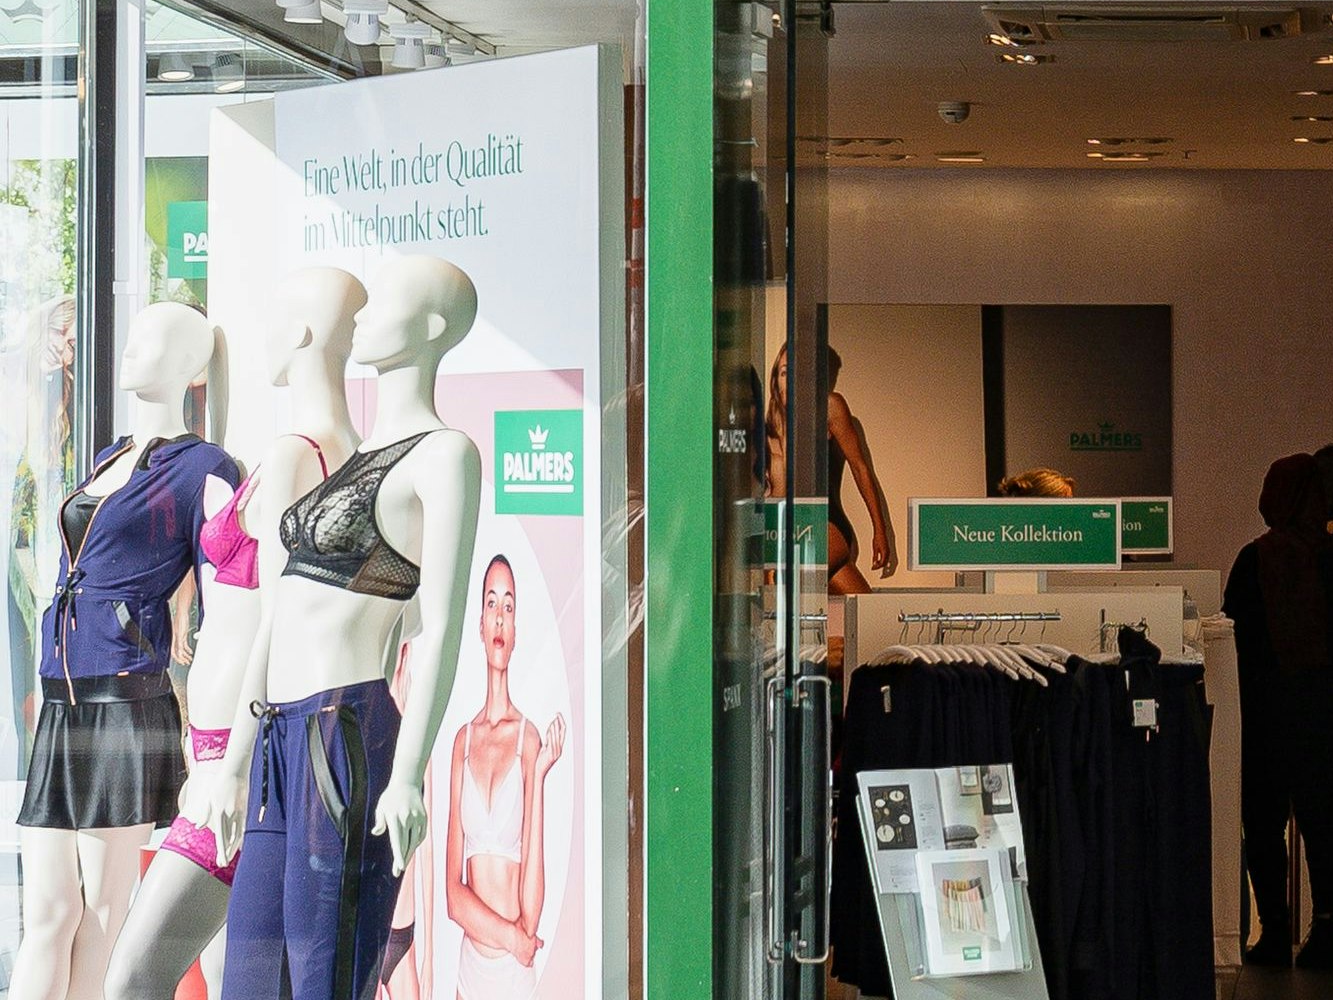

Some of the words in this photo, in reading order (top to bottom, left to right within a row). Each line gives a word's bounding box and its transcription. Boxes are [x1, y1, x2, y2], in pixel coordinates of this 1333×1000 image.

[303, 158, 340, 197] Eine
[343, 148, 387, 195] Welt,
[390, 148, 407, 187] in
[411, 142, 443, 186] der
[446, 133, 524, 187] Qualität
[303, 215, 326, 252] im
[330, 199, 433, 256] Mittelpunkt
[437, 194, 489, 240] steht.
[1069, 430, 1142, 447] PALMERS
[503, 451, 575, 482] PALMERS
[953, 525, 996, 542] Neue
[1000, 525, 1083, 542] Kollektion
